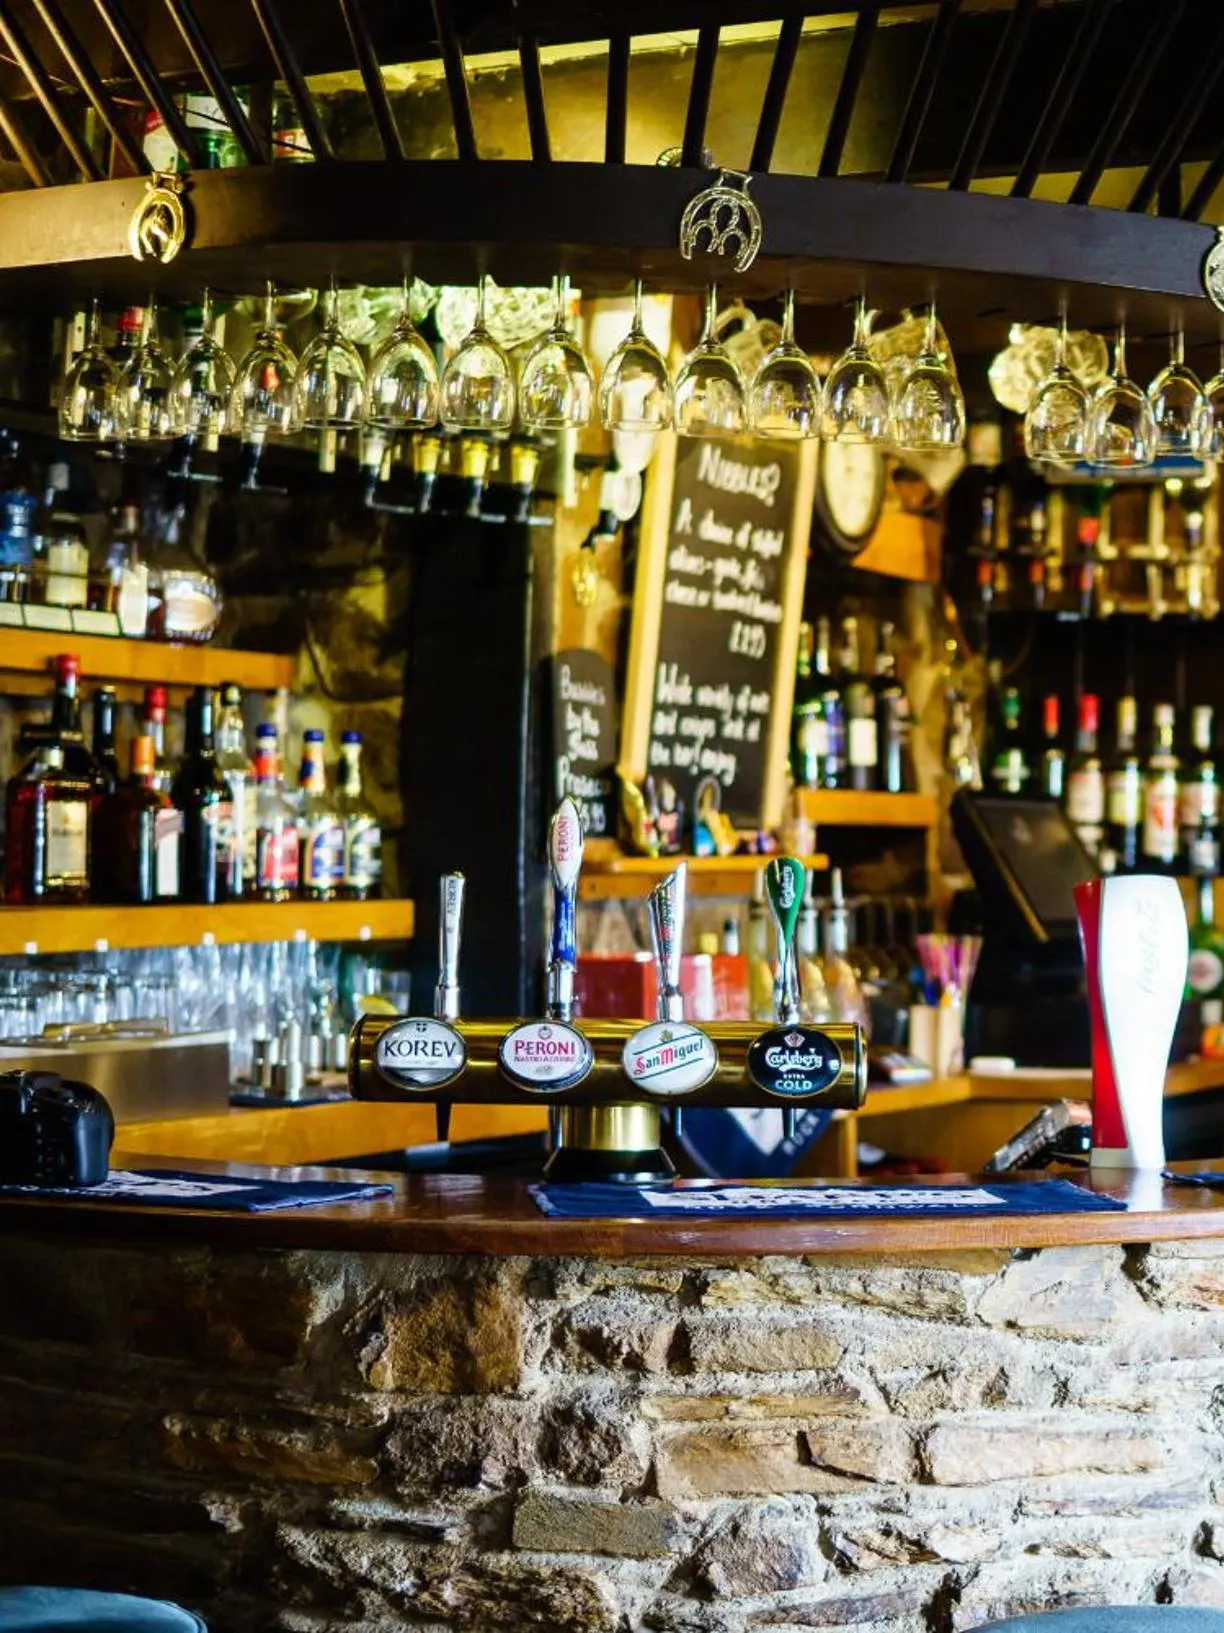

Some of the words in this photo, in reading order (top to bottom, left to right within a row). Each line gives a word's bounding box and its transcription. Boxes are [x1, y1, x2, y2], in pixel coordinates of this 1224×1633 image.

[675, 498, 692, 534] A
[558, 815, 569, 862] PERONI
[384, 1039, 457, 1058] KOREV
[514, 1040, 576, 1056] PERONI
[765, 1046, 823, 1072] Carlsberg
[774, 1079, 813, 1091] COLD
